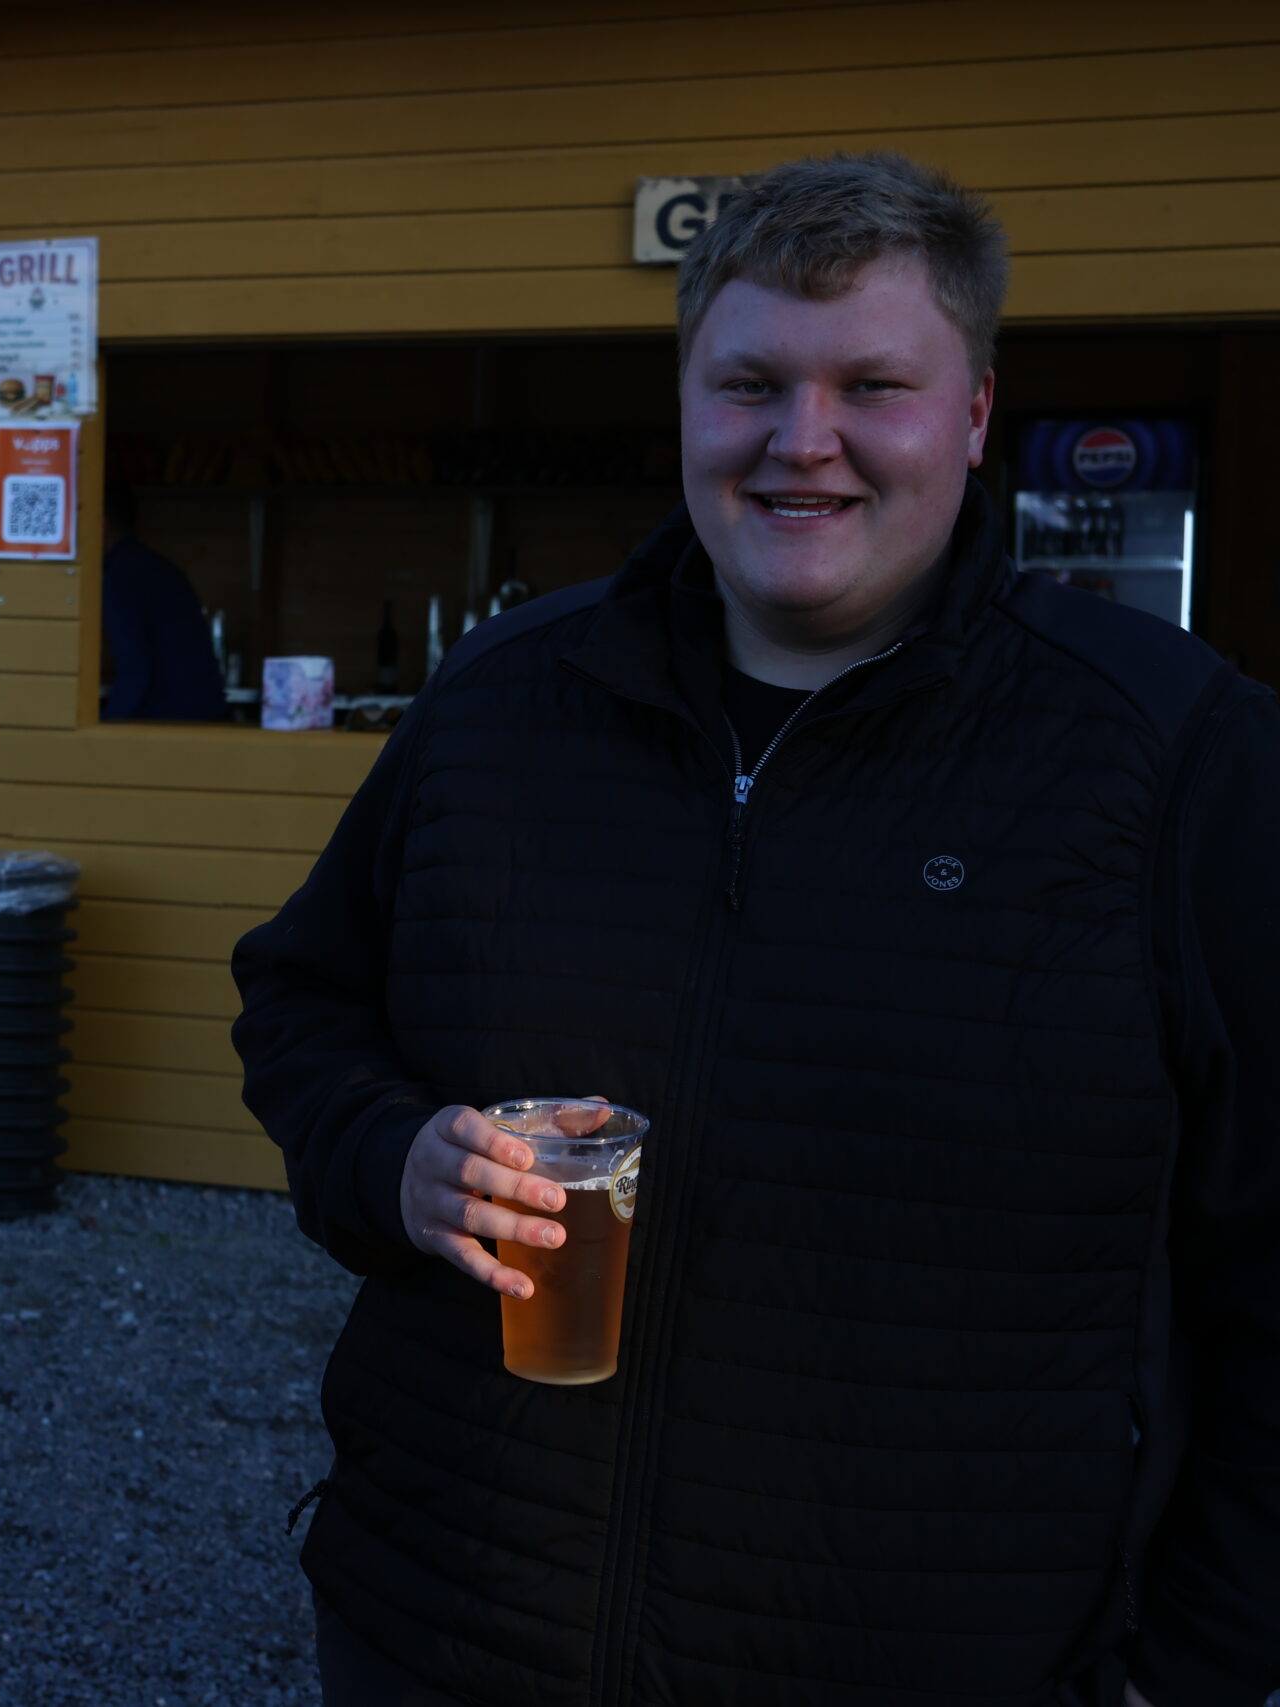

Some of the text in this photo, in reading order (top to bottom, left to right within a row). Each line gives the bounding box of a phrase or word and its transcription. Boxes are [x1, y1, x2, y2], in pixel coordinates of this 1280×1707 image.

[1079, 452, 1131, 464] PEPSI
[933, 858, 960, 869] JACK
[940, 868, 948, 876] &
[927, 875, 959, 888] JONES
